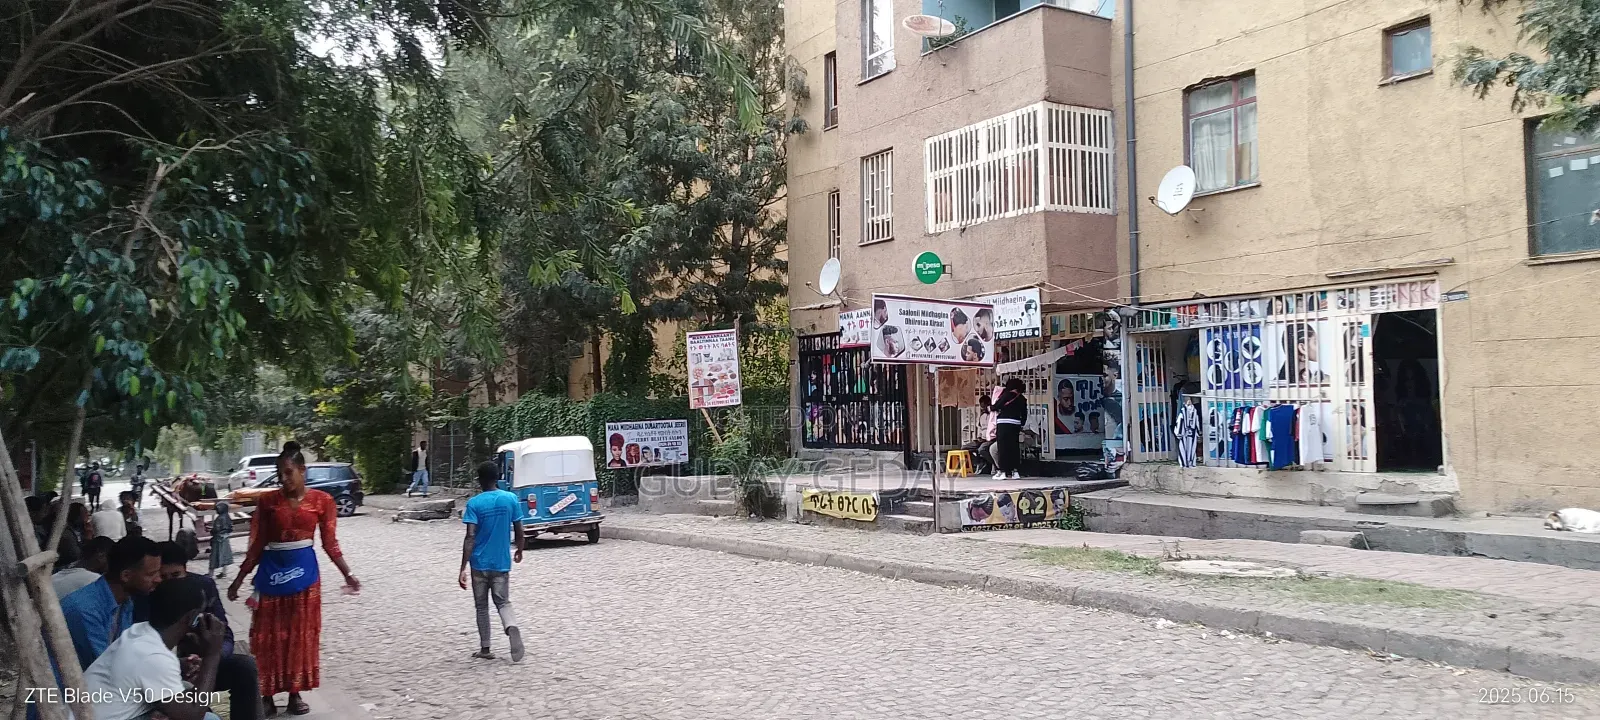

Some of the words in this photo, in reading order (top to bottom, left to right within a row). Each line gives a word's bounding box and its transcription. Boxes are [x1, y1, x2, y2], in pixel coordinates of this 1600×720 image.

[840, 312, 854, 320] MANA
[898, 308, 920, 317] Saalonii
[921, 310, 949, 319] Miidhagina
[999, 331, 1011, 340] 0925
[1012, 330, 1018, 338] 27
[1019, 329, 1025, 337] 65
